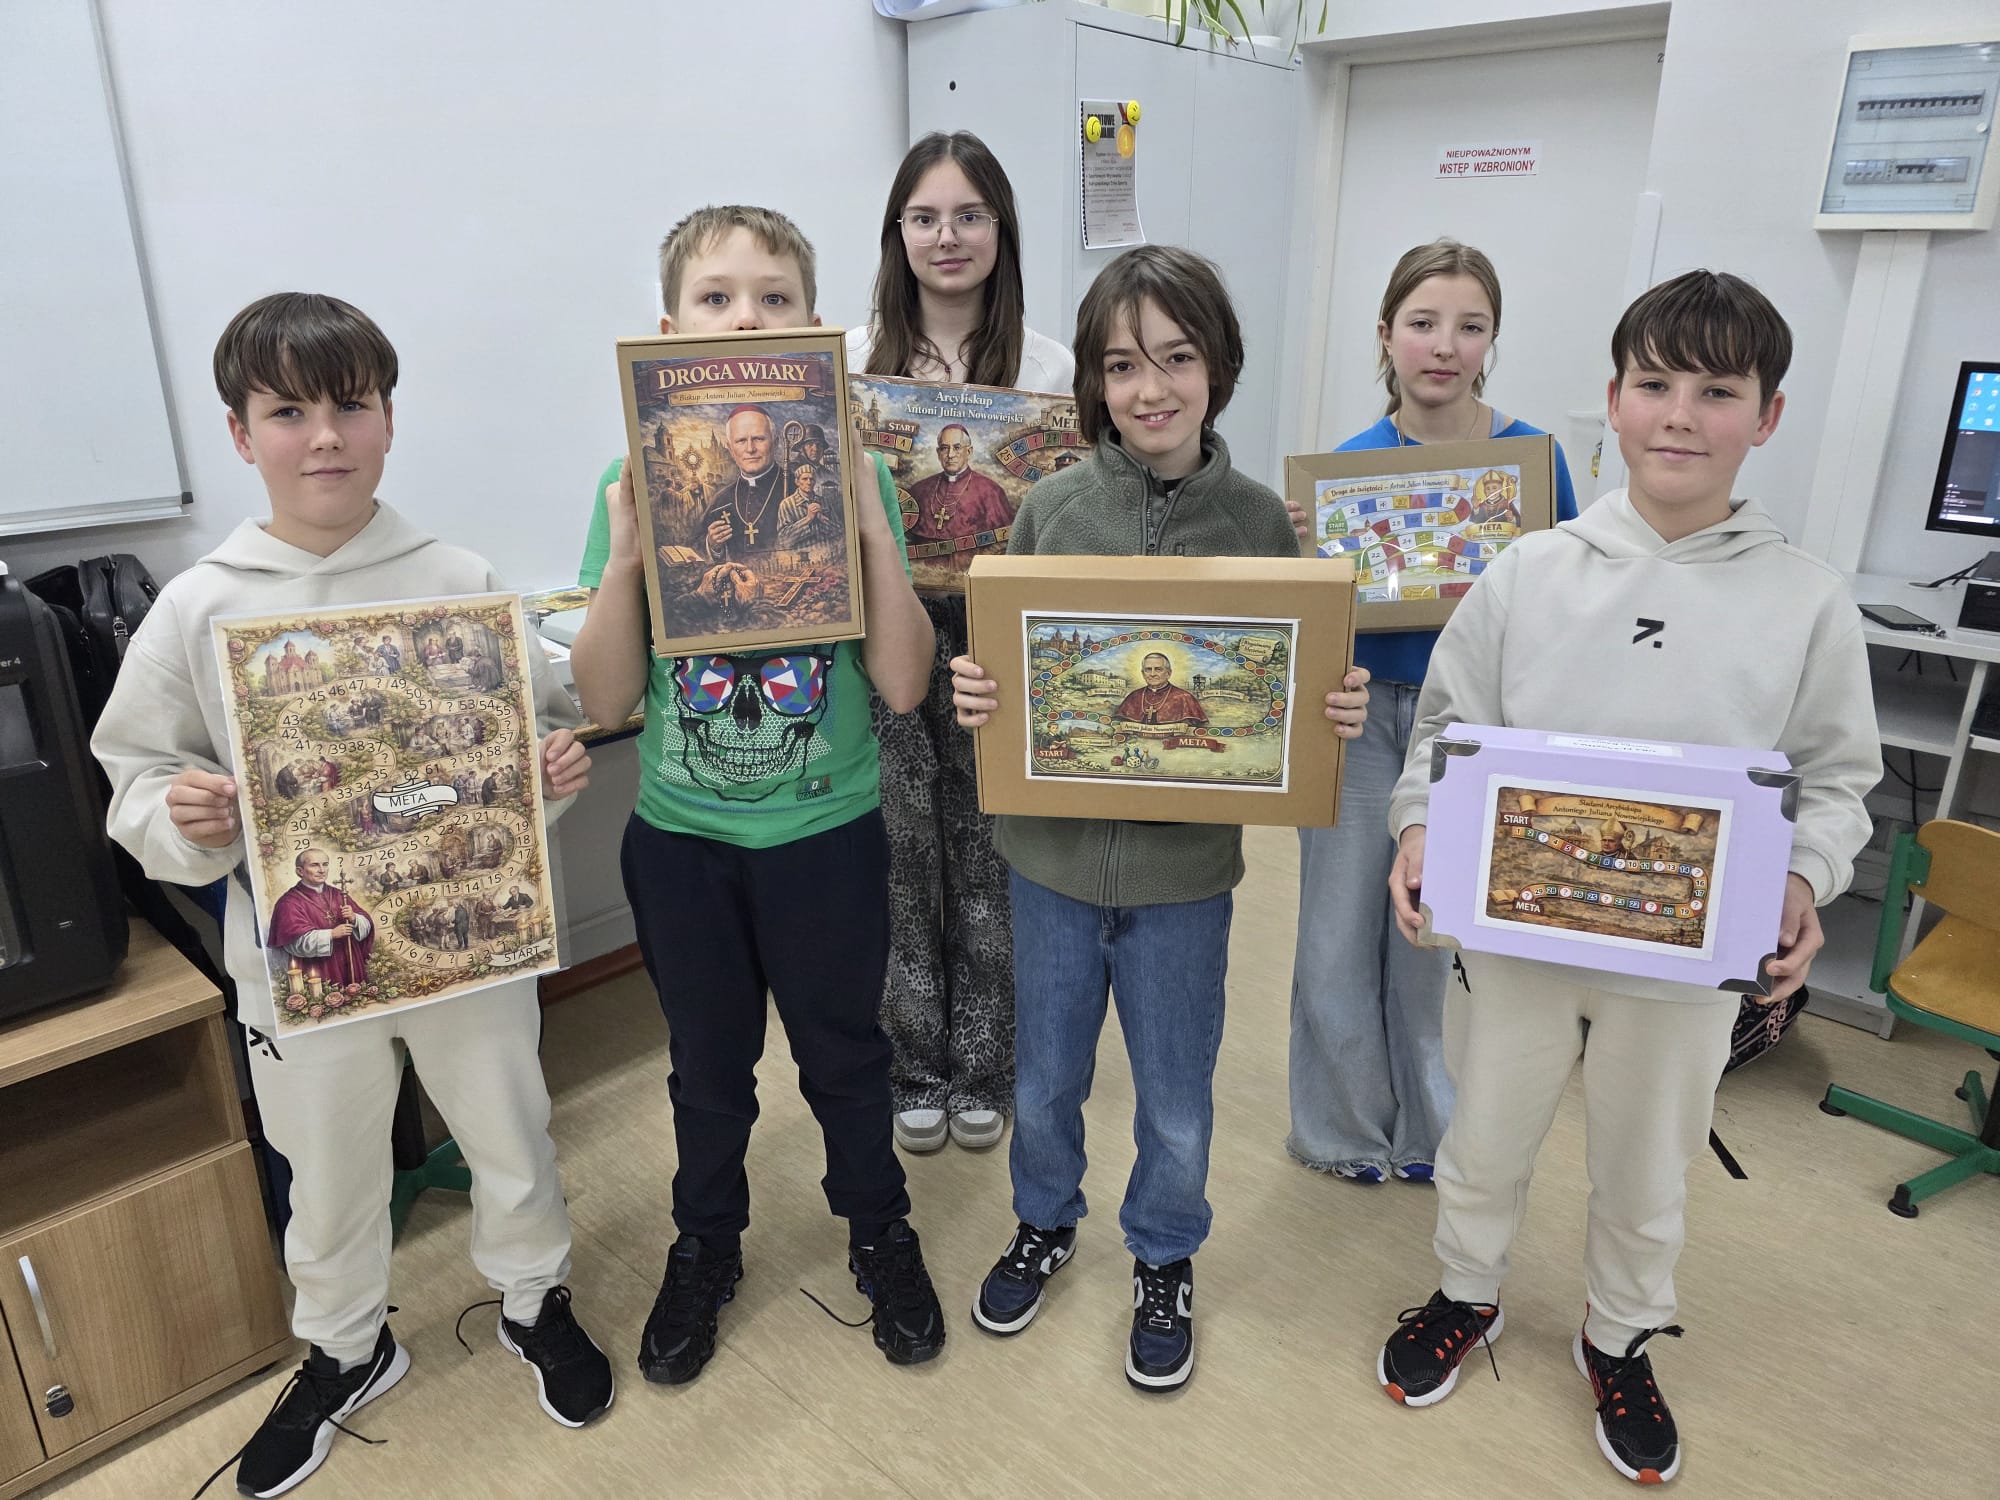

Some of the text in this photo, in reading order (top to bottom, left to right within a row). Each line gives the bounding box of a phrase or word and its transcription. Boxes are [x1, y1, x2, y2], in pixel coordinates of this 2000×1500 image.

[1446, 147, 1530, 158] NIEUPOWAŻNIONYM
[1440, 160, 1535, 176] WSTĘP WZBRONIONY
[656, 362, 809, 390] DROGA WIARY
[904, 404, 936, 414] Antoni
[968, 409, 1023, 424] Nowowiejski
[1052, 416, 1078, 428] MET
[888, 422, 916, 433] START
[1000, 450, 1012, 461] 25
[349, 680, 364, 690] 47
[391, 679, 406, 689] 49
[309, 690, 326, 702] 45
[329, 686, 346, 696] 46
[406, 688, 421, 699] 50
[420, 699, 433, 710] 51
[460, 700, 476, 710] 53
[480, 700, 494, 710] 54
[496, 706, 510, 716] 55
[283, 715, 300, 726] 43
[282, 729, 298, 739] 42
[500, 732, 513, 743] 57
[296, 740, 311, 750] 41
[330, 744, 346, 754] 39
[348, 741, 365, 752] 38
[367, 742, 382, 752] 37
[487, 746, 501, 756] 58
[468, 752, 482, 762] 59
[426, 764, 439, 774] 61
[372, 769, 388, 780] 35
[404, 770, 419, 780] 62
[356, 781, 372, 792] 34
[336, 788, 352, 799] 33
[390, 793, 427, 807] META
[302, 808, 315, 818] 31
[1553, 806, 1586, 814] Antoniego
[455, 815, 469, 825] 22
[476, 811, 488, 821] 21
[1504, 814, 1529, 825] START
[291, 820, 308, 831] 30
[439, 824, 454, 835] 23
[516, 821, 528, 831] 19
[294, 839, 310, 850] 29
[518, 835, 530, 845] 18
[402, 841, 418, 851] 25
[380, 849, 395, 860] 26
[519, 849, 530, 860] 17
[358, 855, 372, 866] 27
[488, 874, 501, 883] 15
[446, 883, 460, 893] 13
[466, 882, 479, 892] 14
[407, 891, 419, 901] 11
[388, 897, 402, 908] 10
[1516, 902, 1540, 912] META
[380, 915, 387, 925] 9
[396, 941, 403, 950] 7
[410, 949, 417, 959] 6
[426, 953, 433, 963] 5
[468, 954, 474, 963] 3
[483, 950, 490, 959] 2
[504, 946, 540, 962] START
